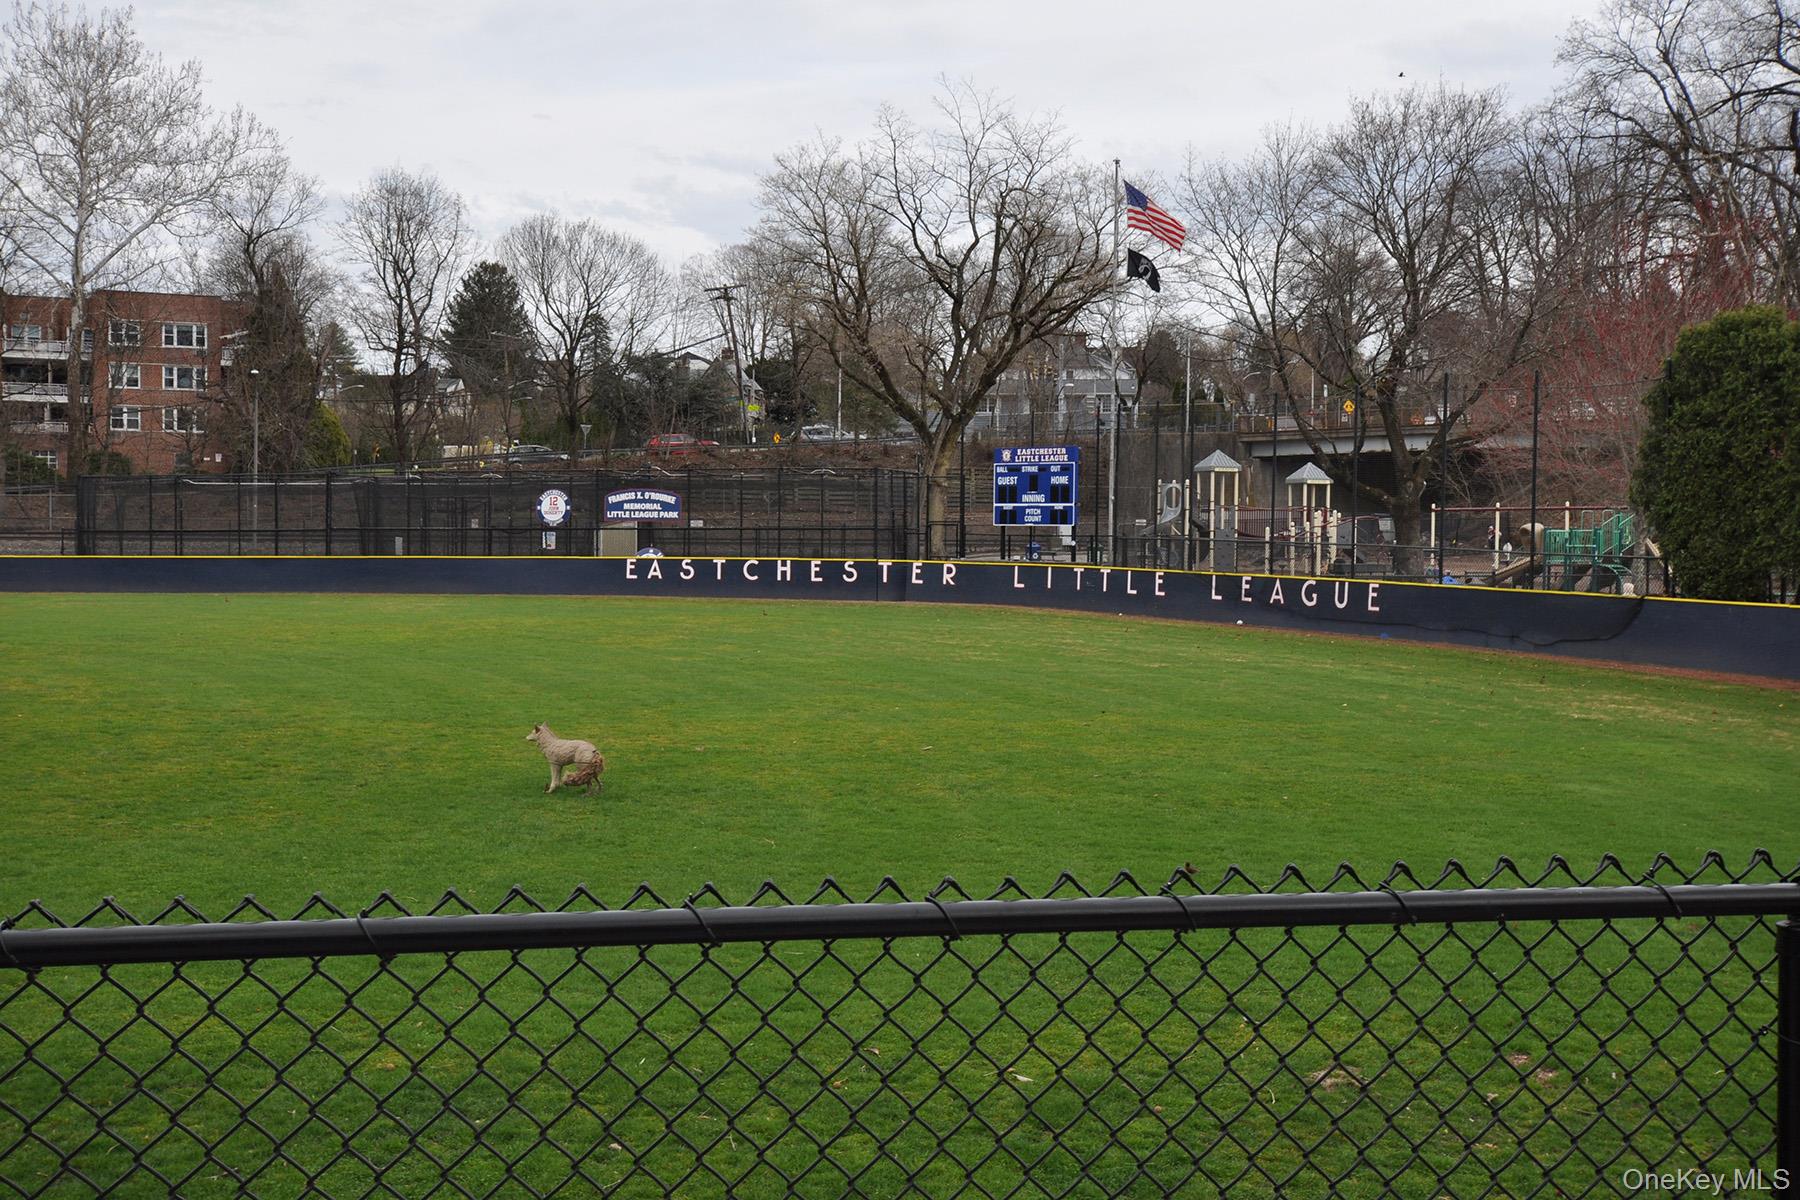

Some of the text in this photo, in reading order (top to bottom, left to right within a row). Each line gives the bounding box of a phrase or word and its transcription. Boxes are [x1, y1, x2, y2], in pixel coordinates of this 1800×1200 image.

[998, 476, 1018, 485] GUEST
[1050, 475, 1069, 485] HOME
[549, 496, 559, 506] 12
[608, 491, 635, 504] FRANCIS
[1021, 494, 1045, 503] INNING
[625, 558, 1380, 612] EASTCHESTER LITTLE LEAGUE
